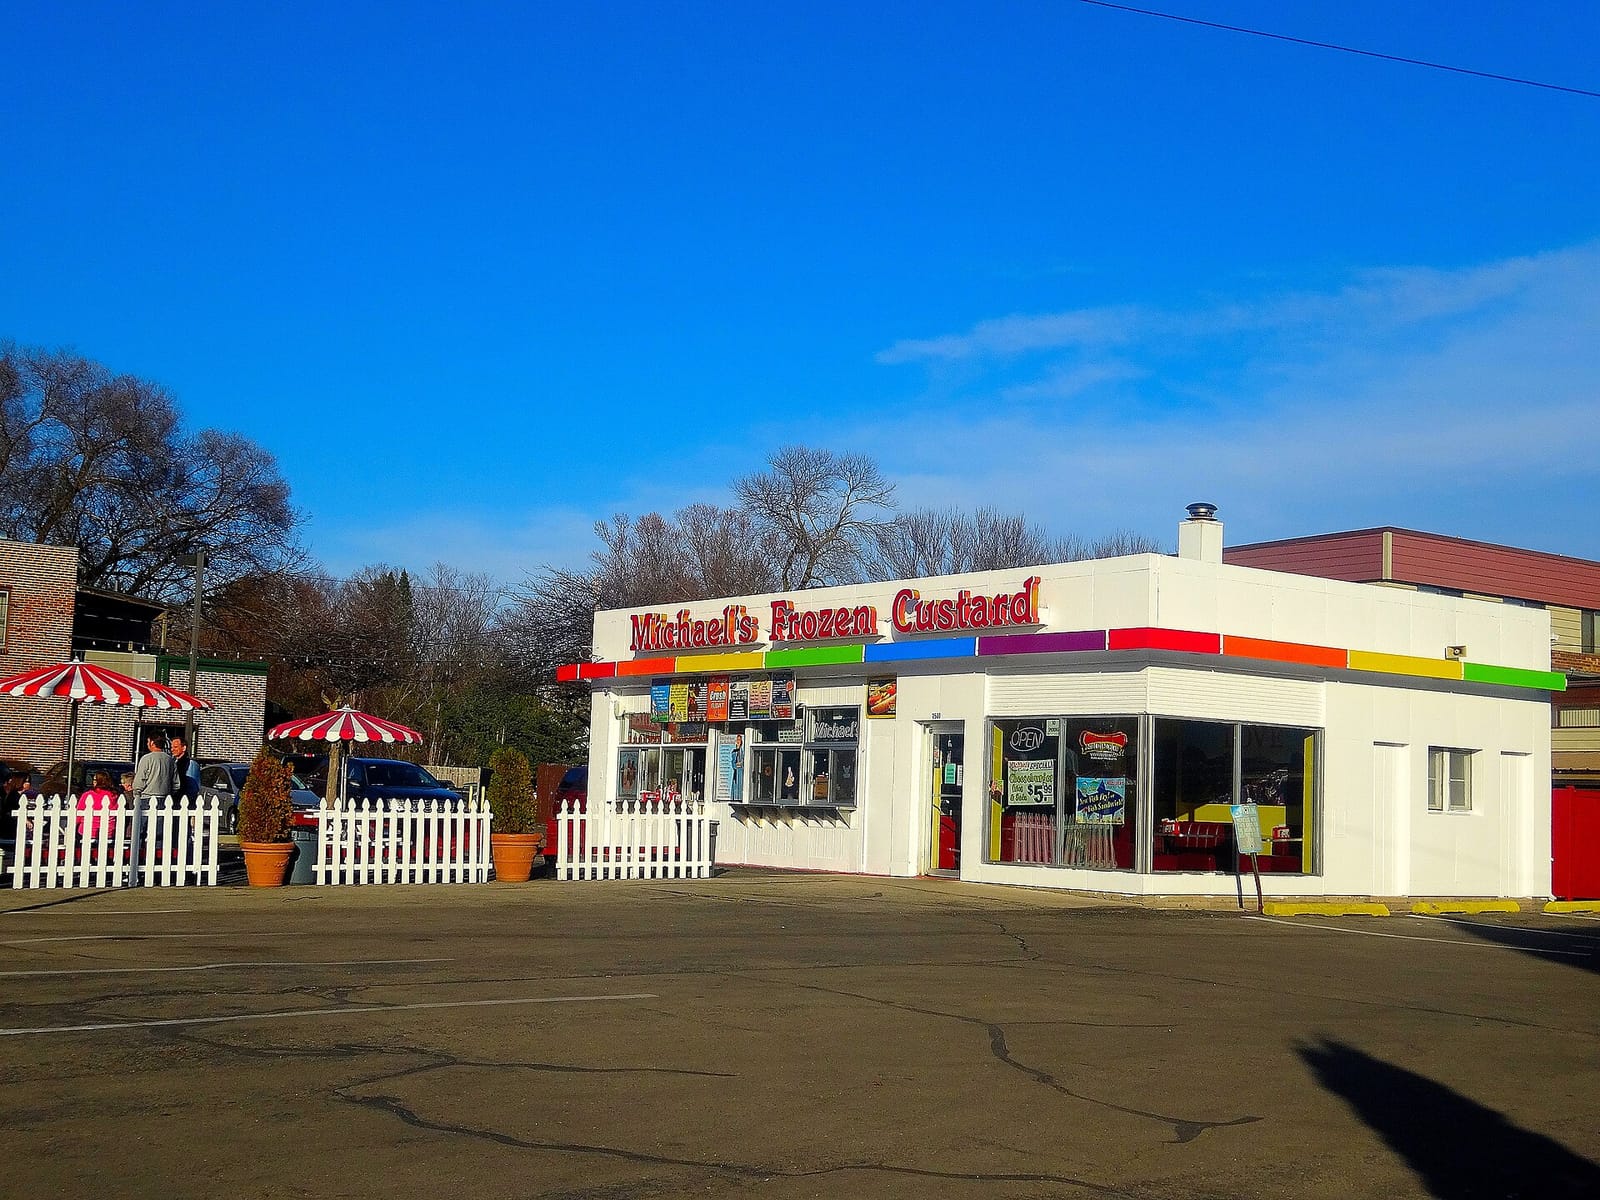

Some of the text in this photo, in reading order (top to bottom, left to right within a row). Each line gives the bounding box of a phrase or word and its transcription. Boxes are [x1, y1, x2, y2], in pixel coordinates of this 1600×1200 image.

[630, 576, 1041, 650] Michael's Frozen Custard
[1011, 730, 1042, 748] OPEN
